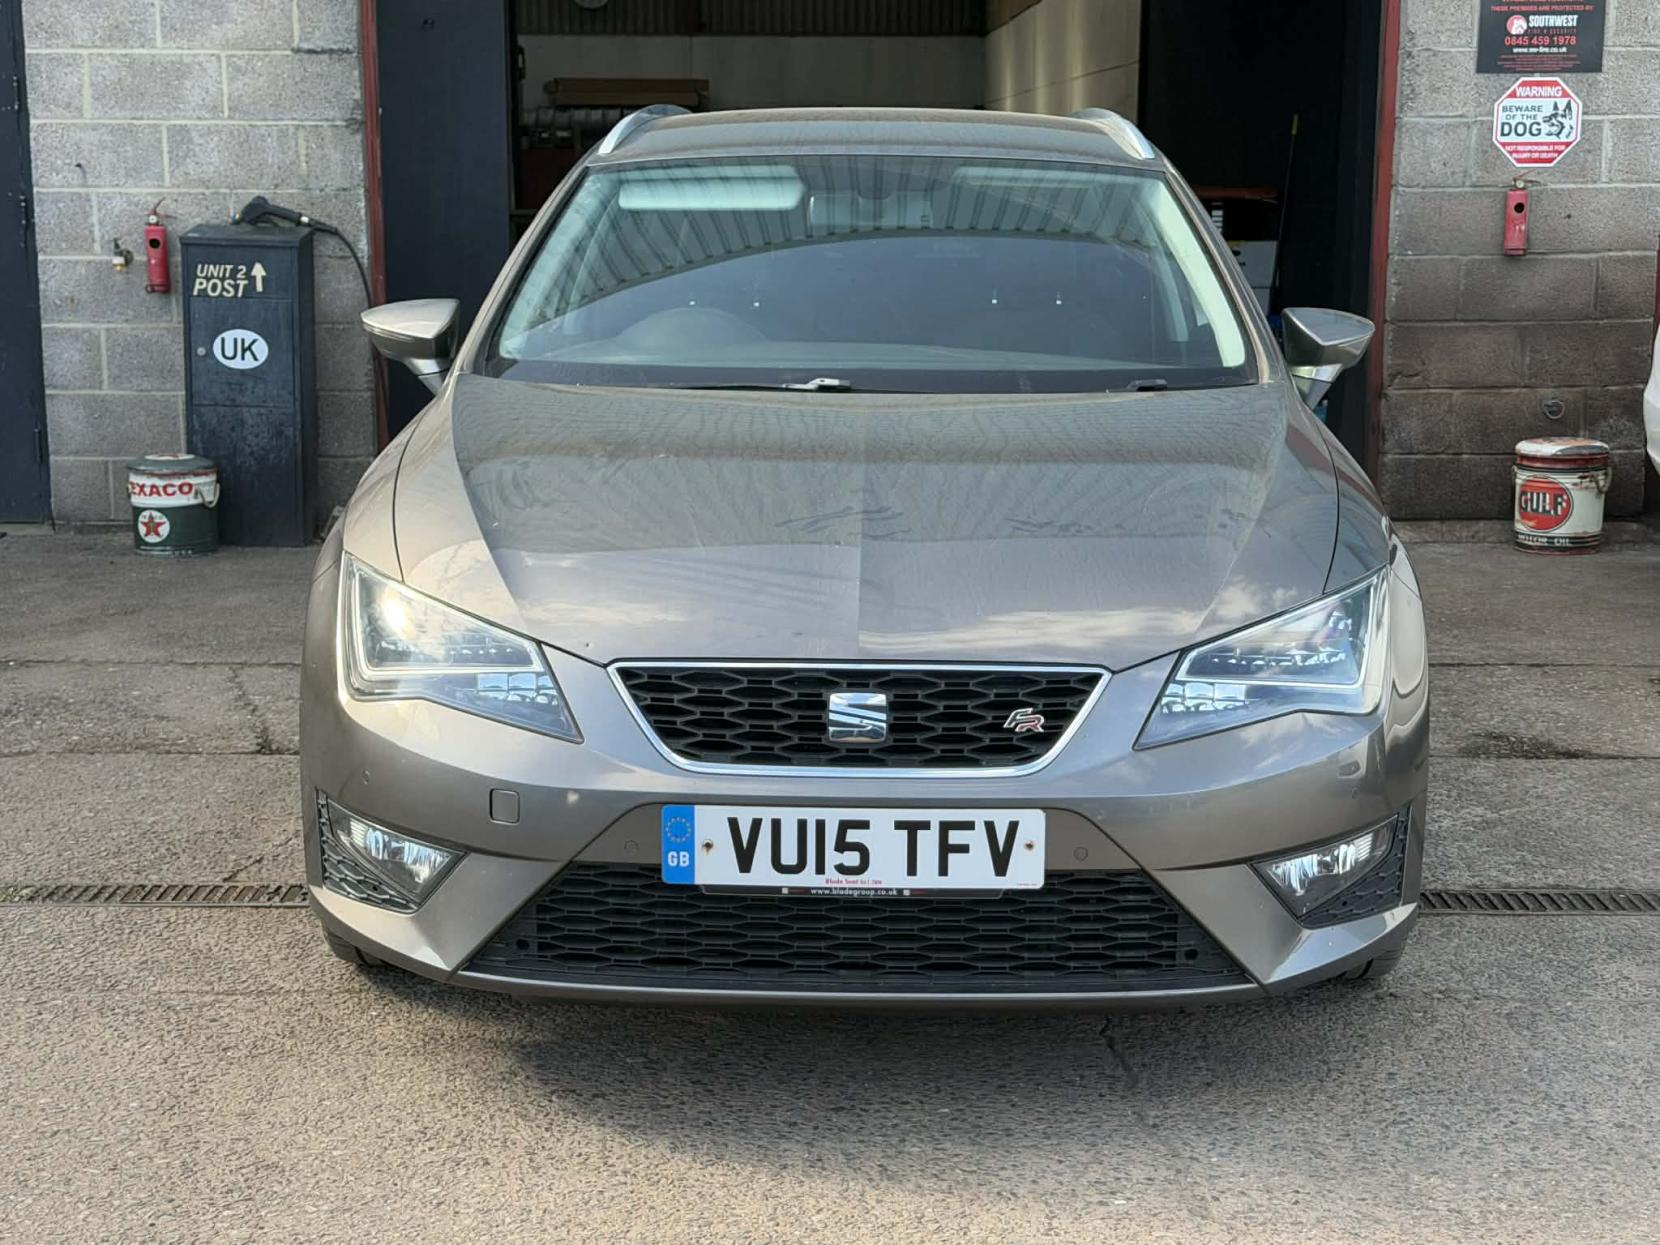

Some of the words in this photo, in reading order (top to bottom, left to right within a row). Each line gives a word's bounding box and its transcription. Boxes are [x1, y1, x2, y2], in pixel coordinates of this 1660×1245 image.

[1528, 14, 1578, 27] SOUTHWEST
[1504, 36, 1529, 46] 0845
[1531, 36, 1550, 46] 459
[1553, 36, 1577, 45] 1978
[1515, 86, 1562, 97] WARNING
[1501, 105, 1543, 113] BEWARE
[1500, 121, 1542, 137] DOG
[196, 264, 233, 278] UNIT
[236, 265, 247, 278] 2
[193, 278, 248, 297] POST
[219, 336, 259, 362] UK
[129, 481, 194, 496] EXACO
[1520, 492, 1567, 516] GULF
[1003, 707, 1045, 733] FR
[727, 816, 871, 876] VU15
[893, 820, 1020, 877] TFV
[667, 850, 690, 867] GB
[810, 886, 898, 897] www.bladegroup.co.uk
